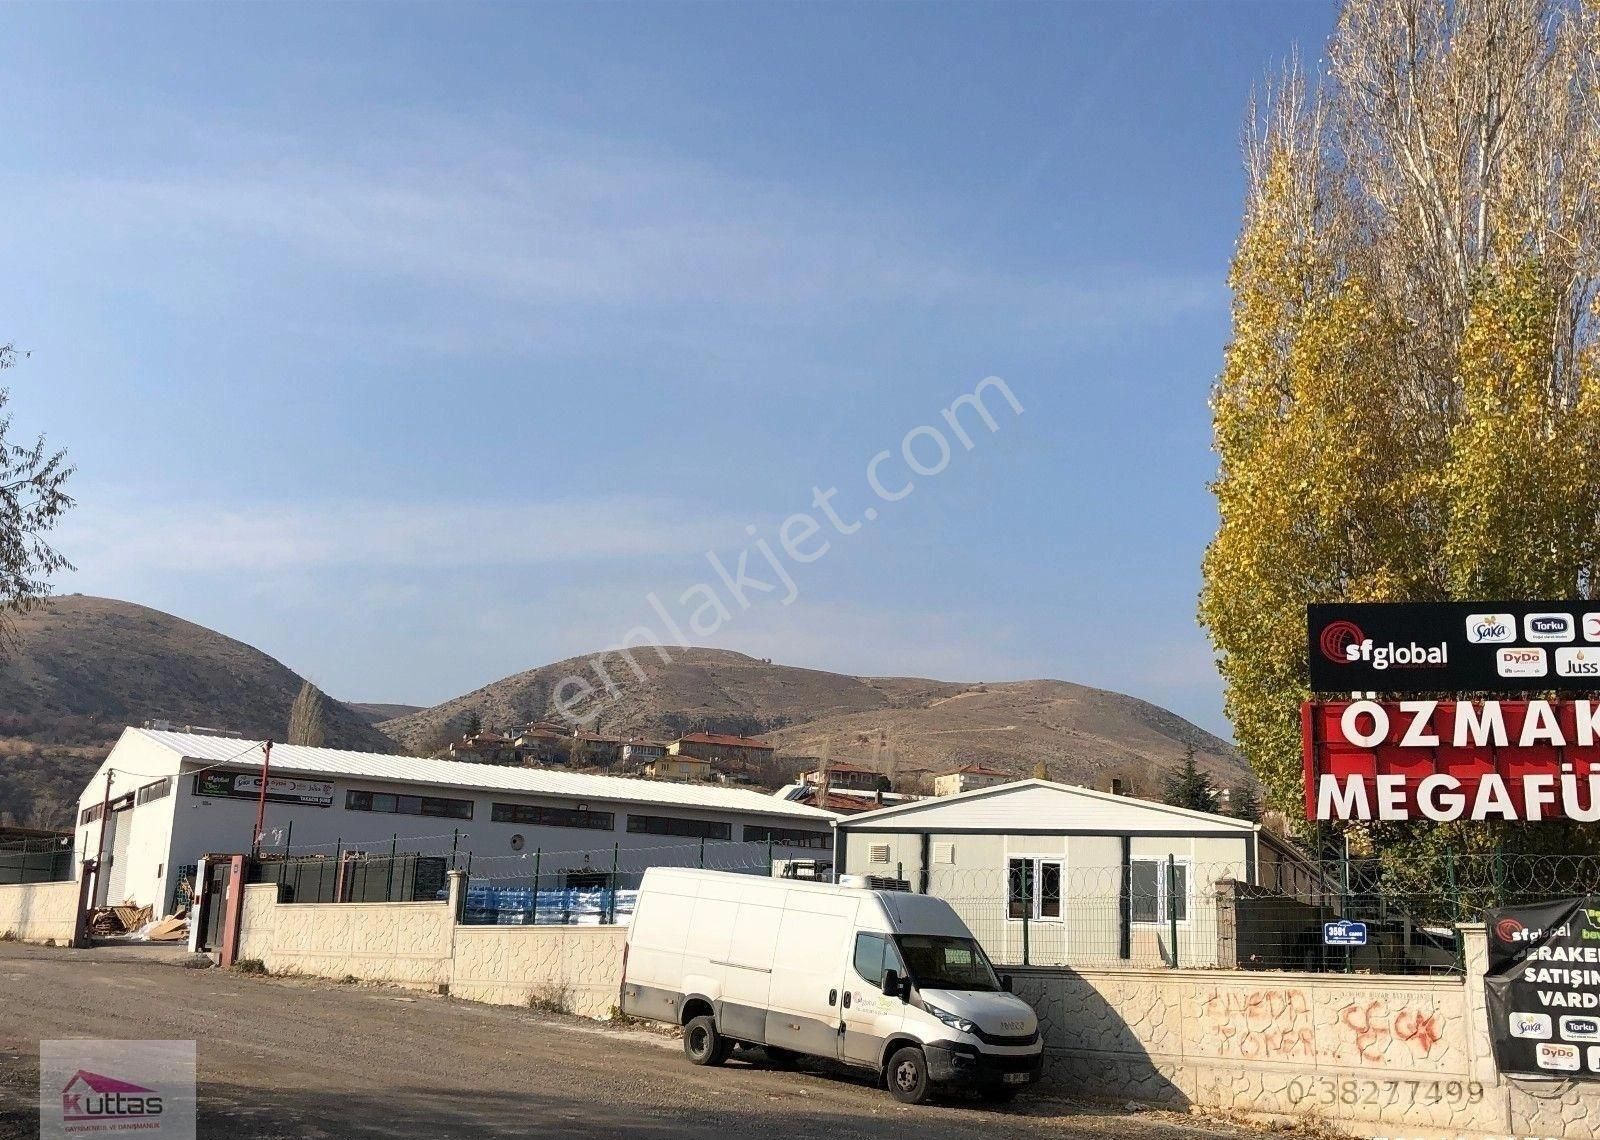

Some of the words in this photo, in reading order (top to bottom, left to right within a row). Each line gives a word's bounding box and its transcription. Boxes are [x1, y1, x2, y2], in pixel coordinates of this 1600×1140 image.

[1535, 621, 1564, 630] Torku
[1346, 639, 1447, 669] sfglobal
[1503, 653, 1540, 664] DyDo
[1565, 660, 1598, 674] Juss
[1317, 763, 1600, 822] MEGAFÜ
[1513, 945, 1600, 963] ERAKE
[1537, 990, 1600, 1008] VARD
[1569, 1022, 1595, 1031] Torku
[1542, 1048, 1574, 1057] DyDo
